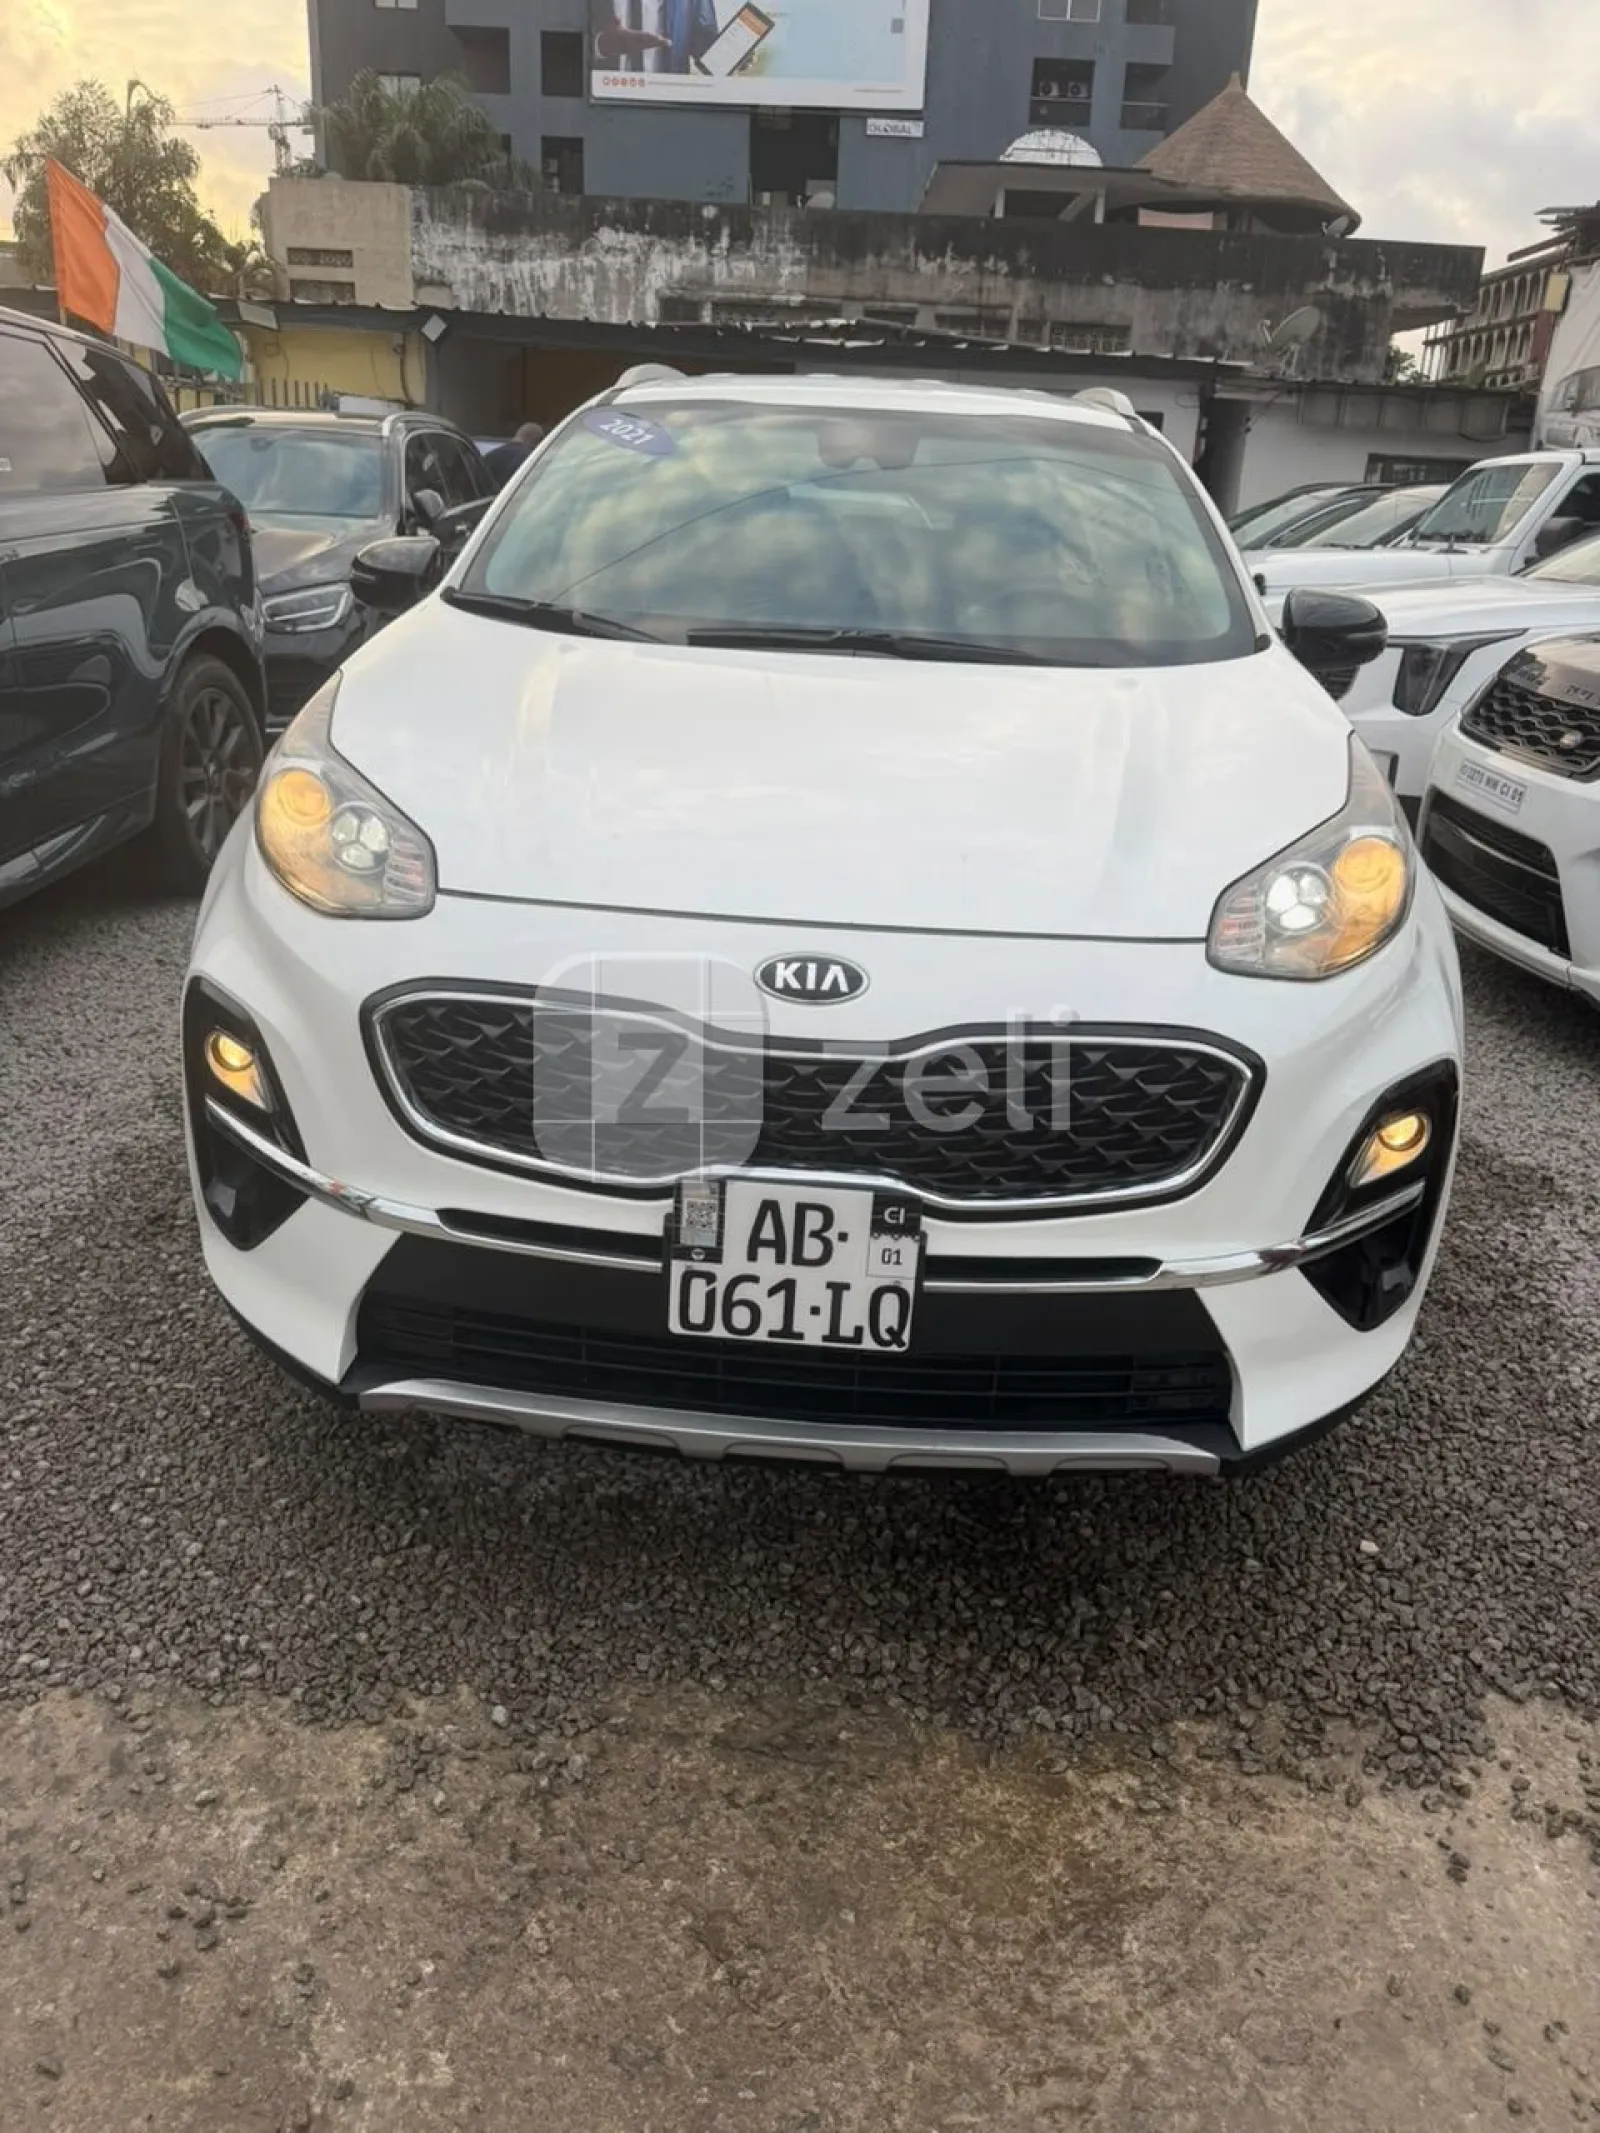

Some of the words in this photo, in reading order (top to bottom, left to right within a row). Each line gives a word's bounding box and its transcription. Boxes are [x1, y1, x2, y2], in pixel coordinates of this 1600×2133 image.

[599, 418, 655, 445] 2021
[774, 960, 849, 993] KIA
[884, 1207, 906, 1225] CI
[881, 1247, 903, 1266] 01
